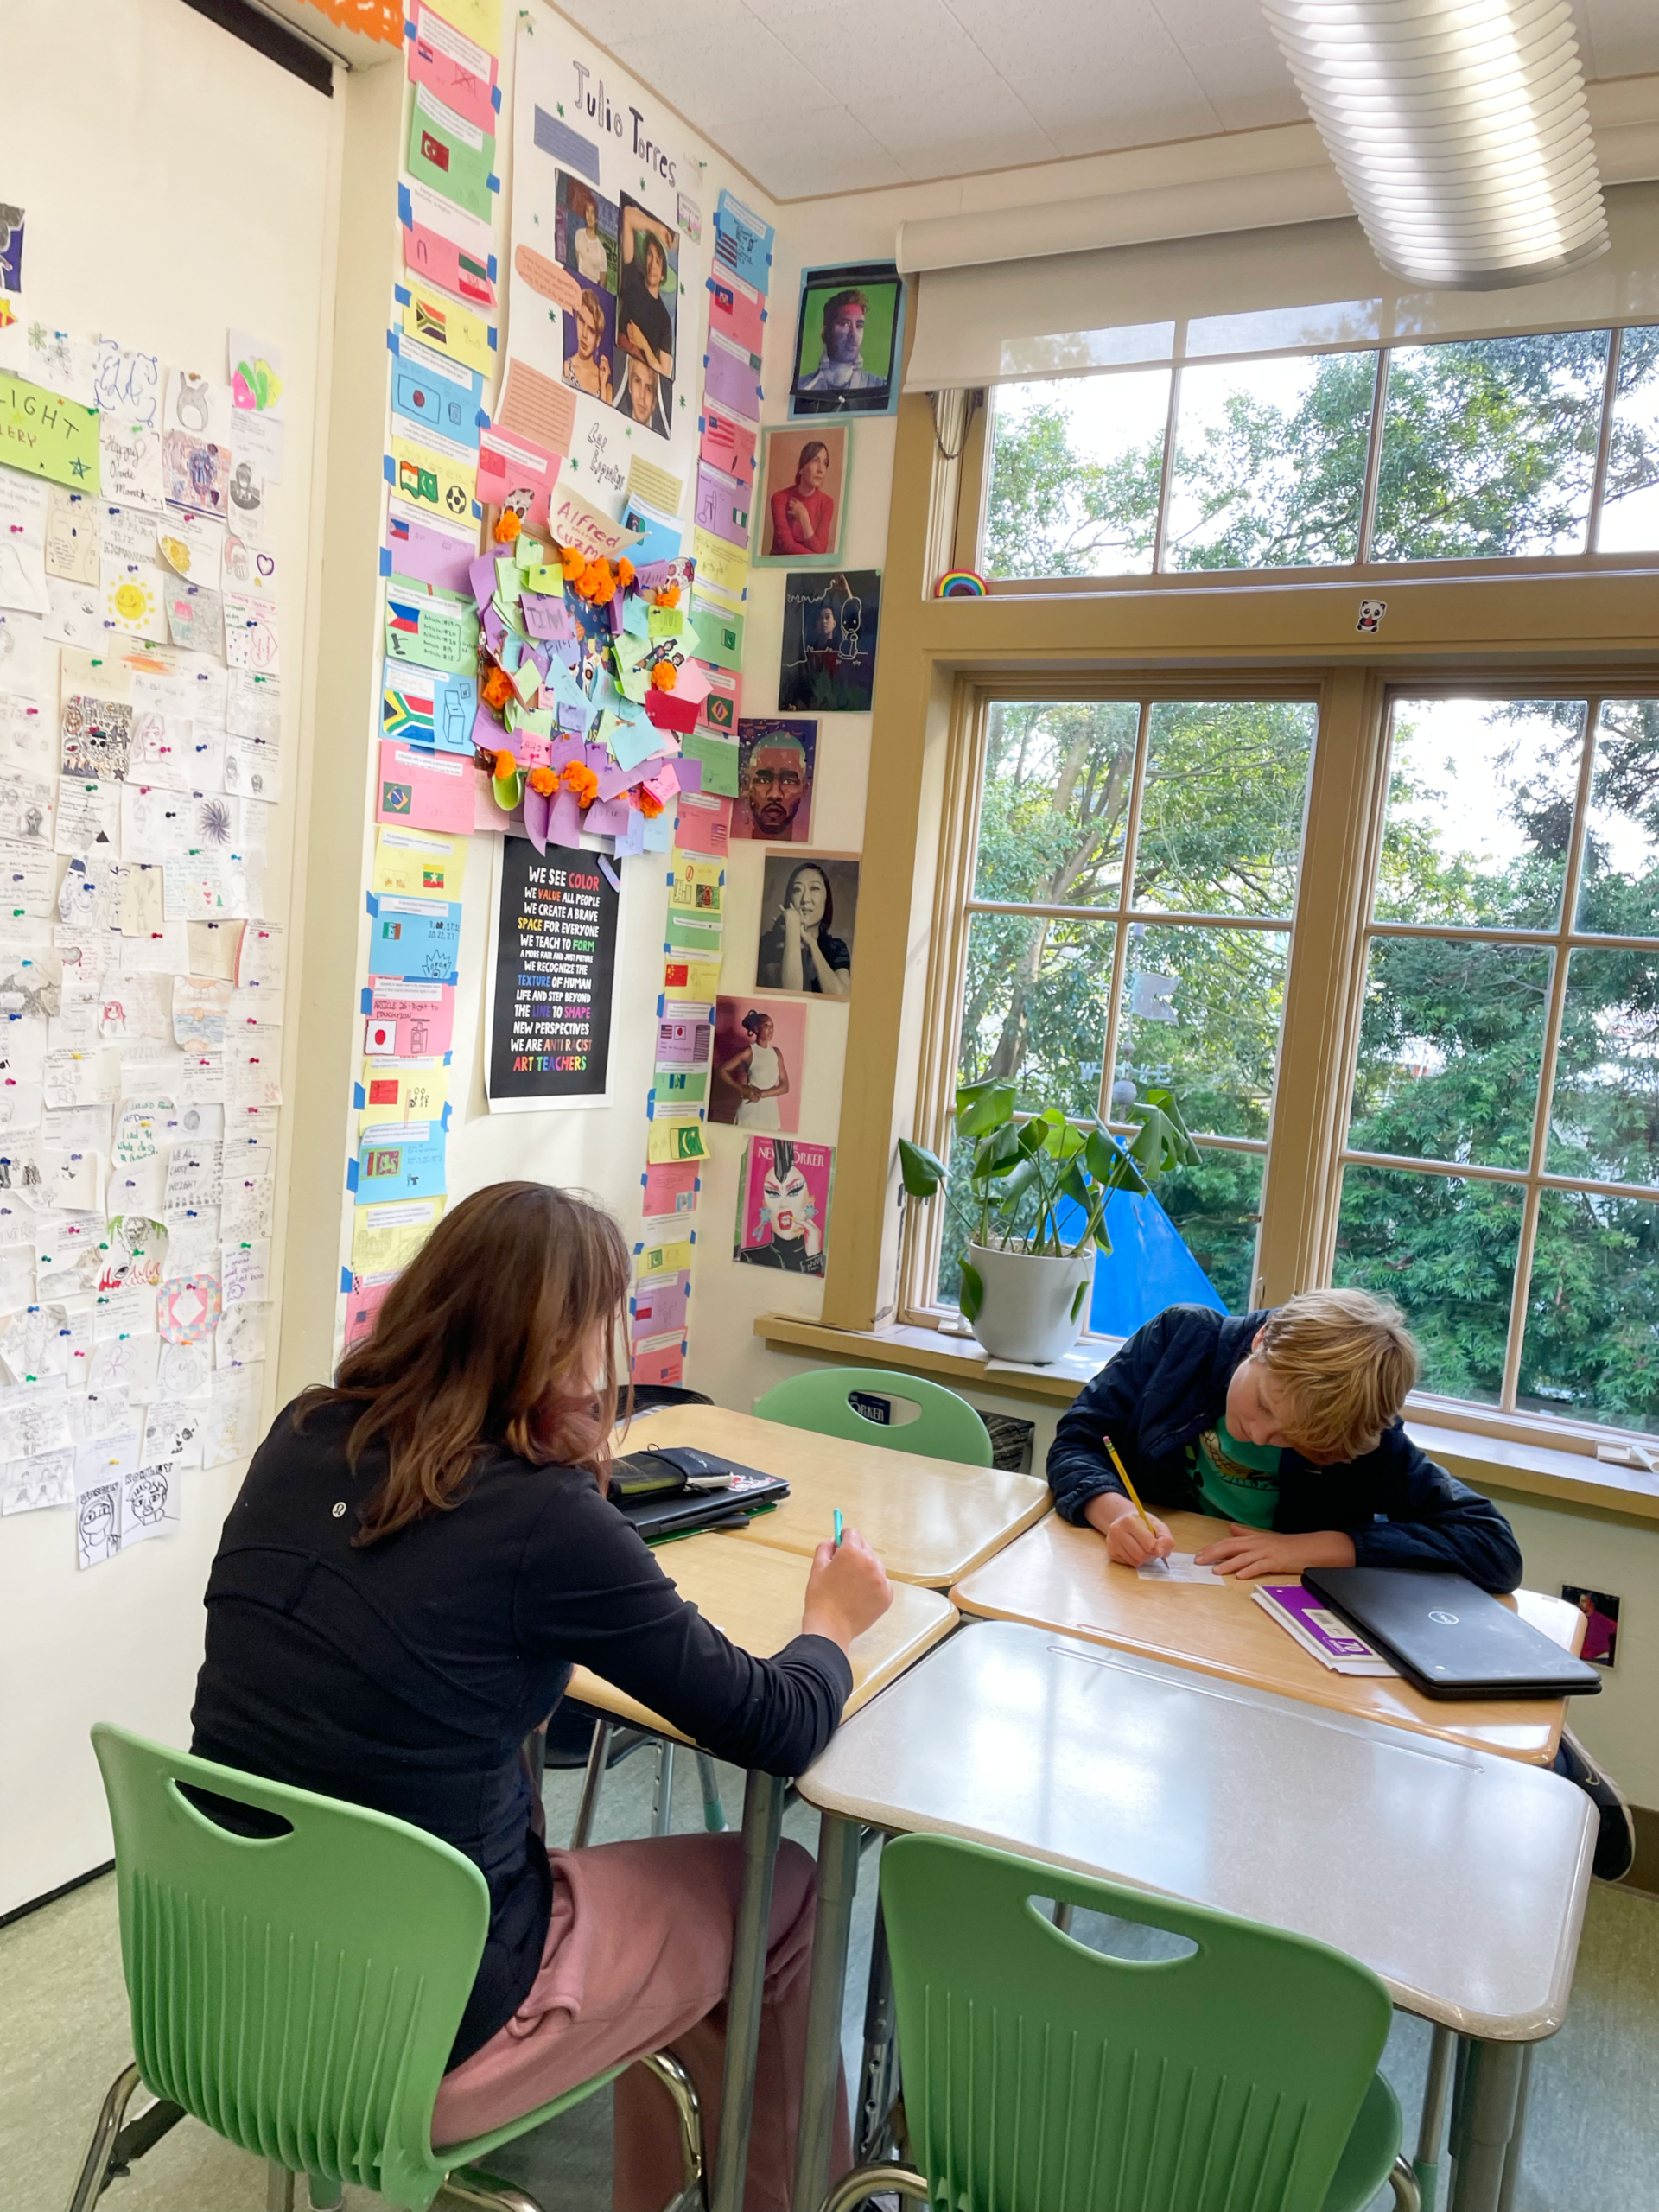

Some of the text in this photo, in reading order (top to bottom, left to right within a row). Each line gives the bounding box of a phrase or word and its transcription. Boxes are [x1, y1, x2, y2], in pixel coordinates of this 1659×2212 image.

[573, 60, 623, 138] Julio
[628, 105, 677, 188] Torres
[0, 389, 79, 440] IGHT
[557, 501, 621, 549] Alfred
[525, 606, 566, 631] TIM
[529, 866, 600, 891] WE SEE COLOR
[524, 887, 601, 907] WE VALUE ALL PEOPLE
[524, 902, 598, 922] WE CREATE A BRAVE
[518, 917, 600, 938] SPACE FOR EVERYONE
[520, 934, 595, 952] WE TEACH TO FORM
[520, 949, 525, 957] A
[525, 950, 539, 959] MORE
[540, 951, 552, 960] FAIR
[553, 952, 564, 961] AND
[575, 954, 594, 963] FUTURE
[524, 960, 588, 976] WE RECOGNIZE THE
[518, 974, 592, 990] TEXTURE OF HUMAN
[516, 989, 591, 1003] LIFE AND STEP BEYOND
[514, 1004, 591, 1019] THE LINE TO SHAPE
[513, 1021, 589, 1035] NEW PERSPECTIVES
[510, 1039, 593, 1052] WE ARE ANTI RACIST
[513, 1056, 587, 1071] ART TEACHERS
[1078, 1061, 1097, 1081] W
[1155, 1064, 1172, 1084] E
[792, 1150, 824, 1167] ORKER
[849, 1402, 885, 1422] ORKER
[1338, 1641, 1365, 1652] 70
